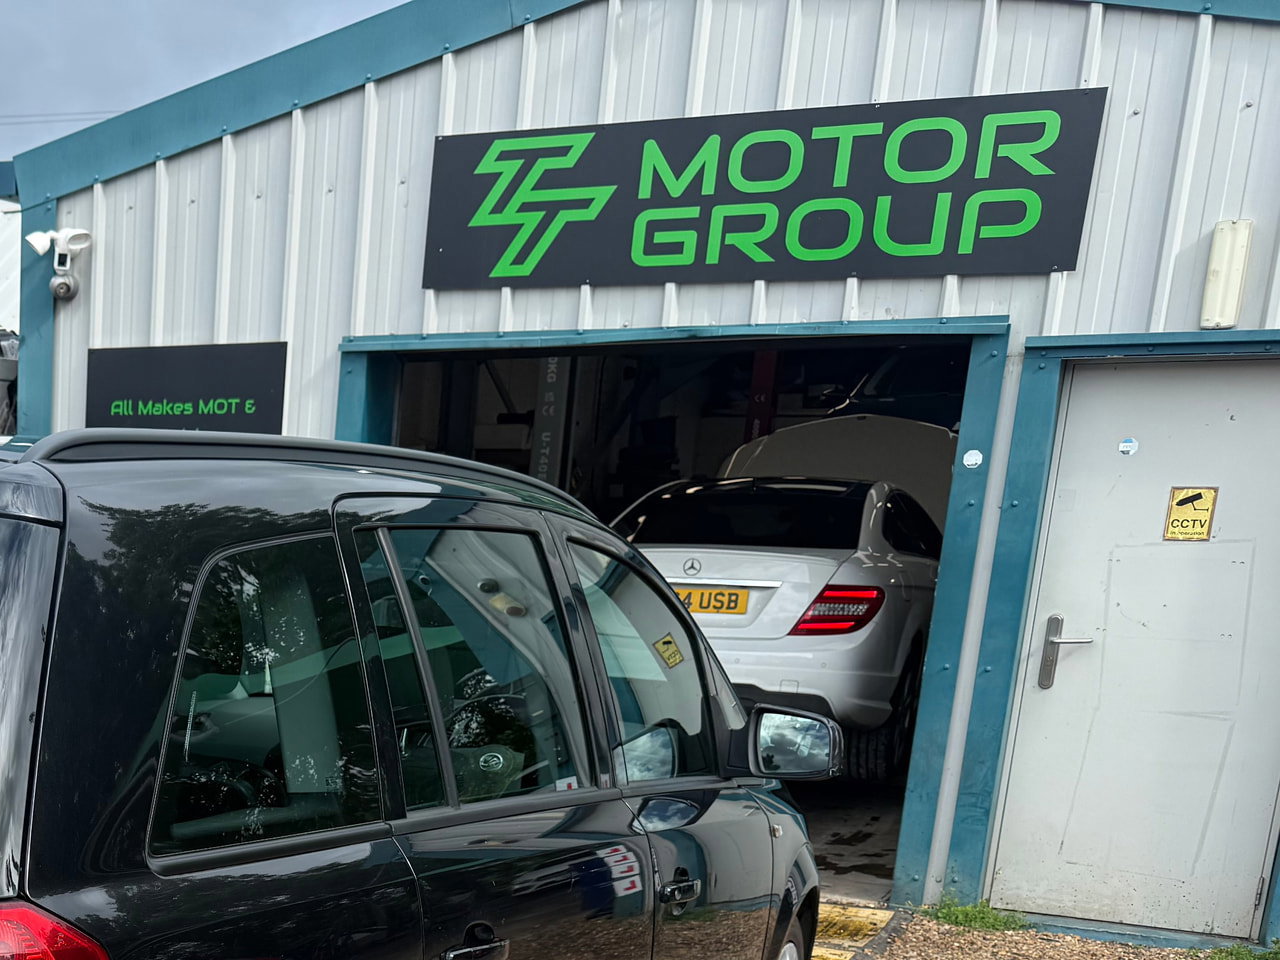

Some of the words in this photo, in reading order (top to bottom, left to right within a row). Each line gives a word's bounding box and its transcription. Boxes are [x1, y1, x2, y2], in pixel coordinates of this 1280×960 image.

[637, 109, 1061, 199] MOTOR
[630, 187, 1042, 267] GROUP
[110, 400, 133, 416] All
[137, 399, 193, 416] Makes
[198, 399, 240, 415] MOT
[244, 400, 256, 415] &
[1170, 518, 1208, 529] CCTV
[698, 591, 740, 610] USB
